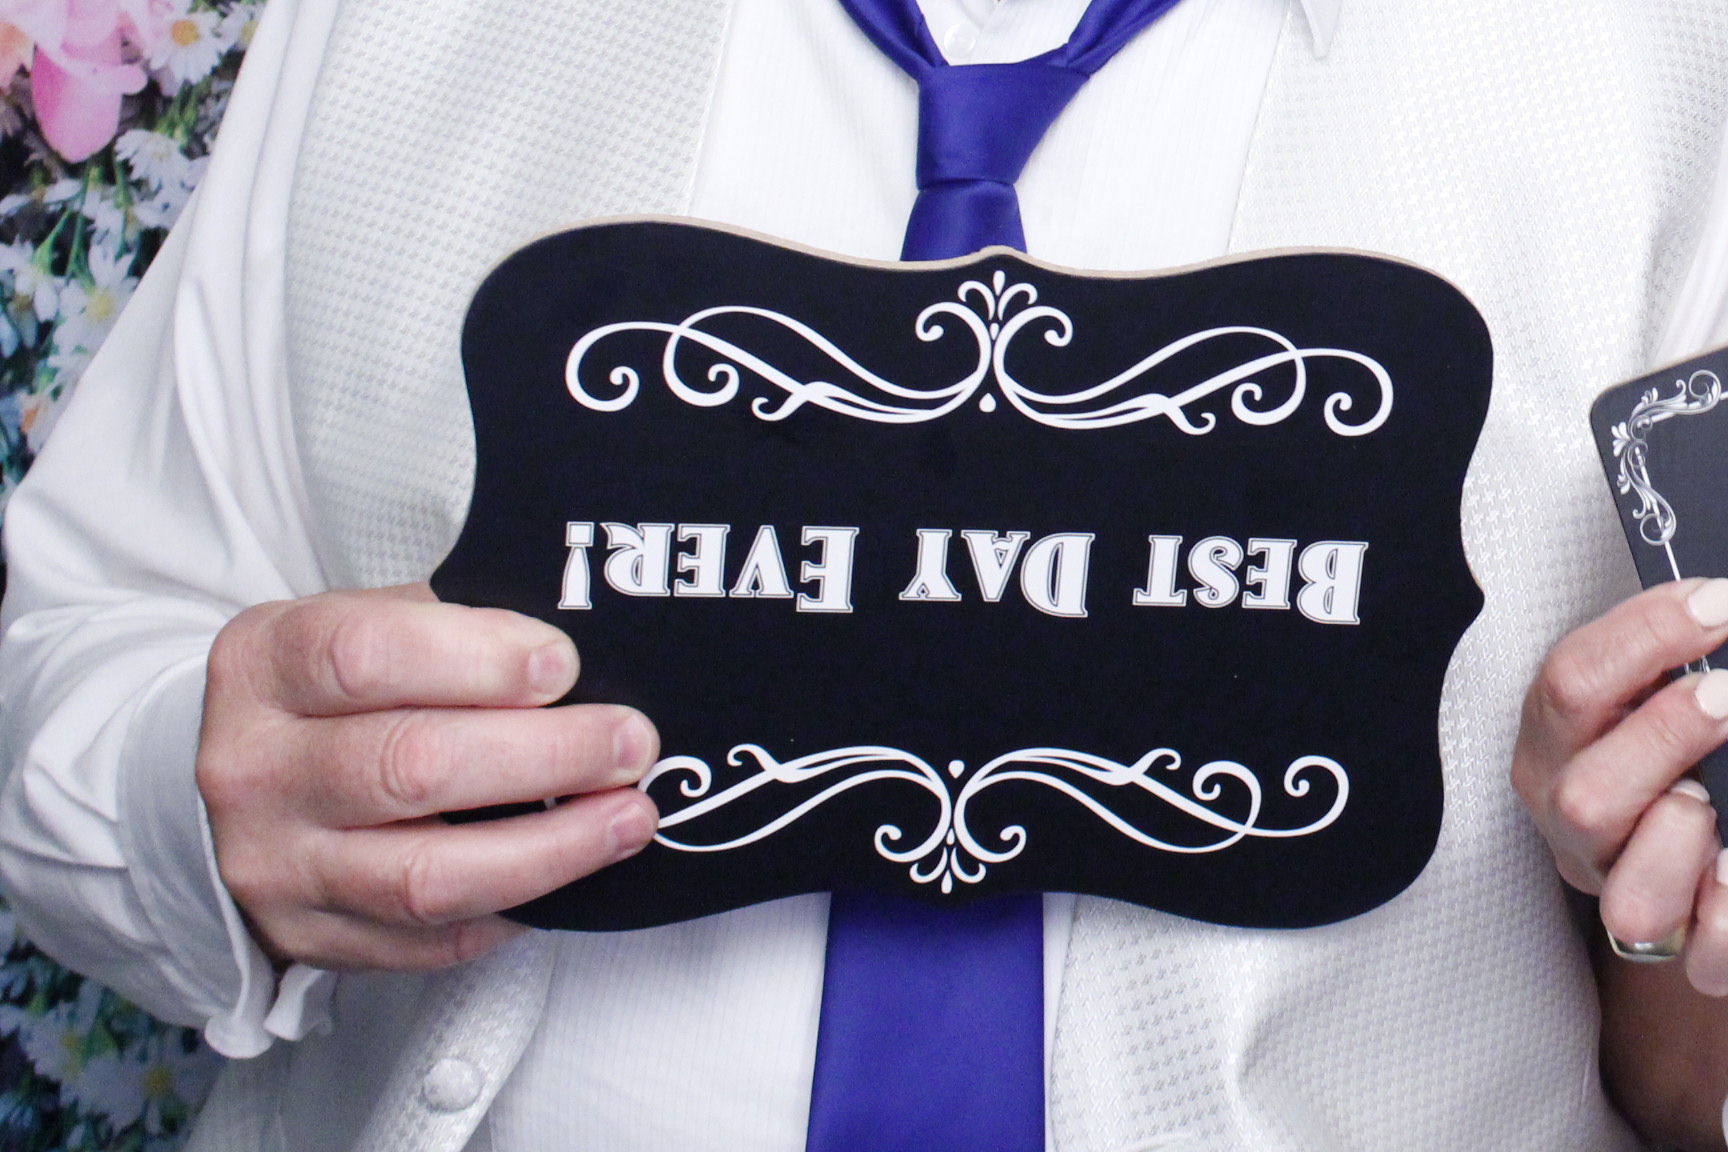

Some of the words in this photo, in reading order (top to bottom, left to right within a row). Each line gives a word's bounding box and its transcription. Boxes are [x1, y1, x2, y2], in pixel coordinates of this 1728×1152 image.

[556, 520, 861, 615] EVER!
[897, 527, 1097, 619] DAY
[1131, 533, 1370, 626] BEST
